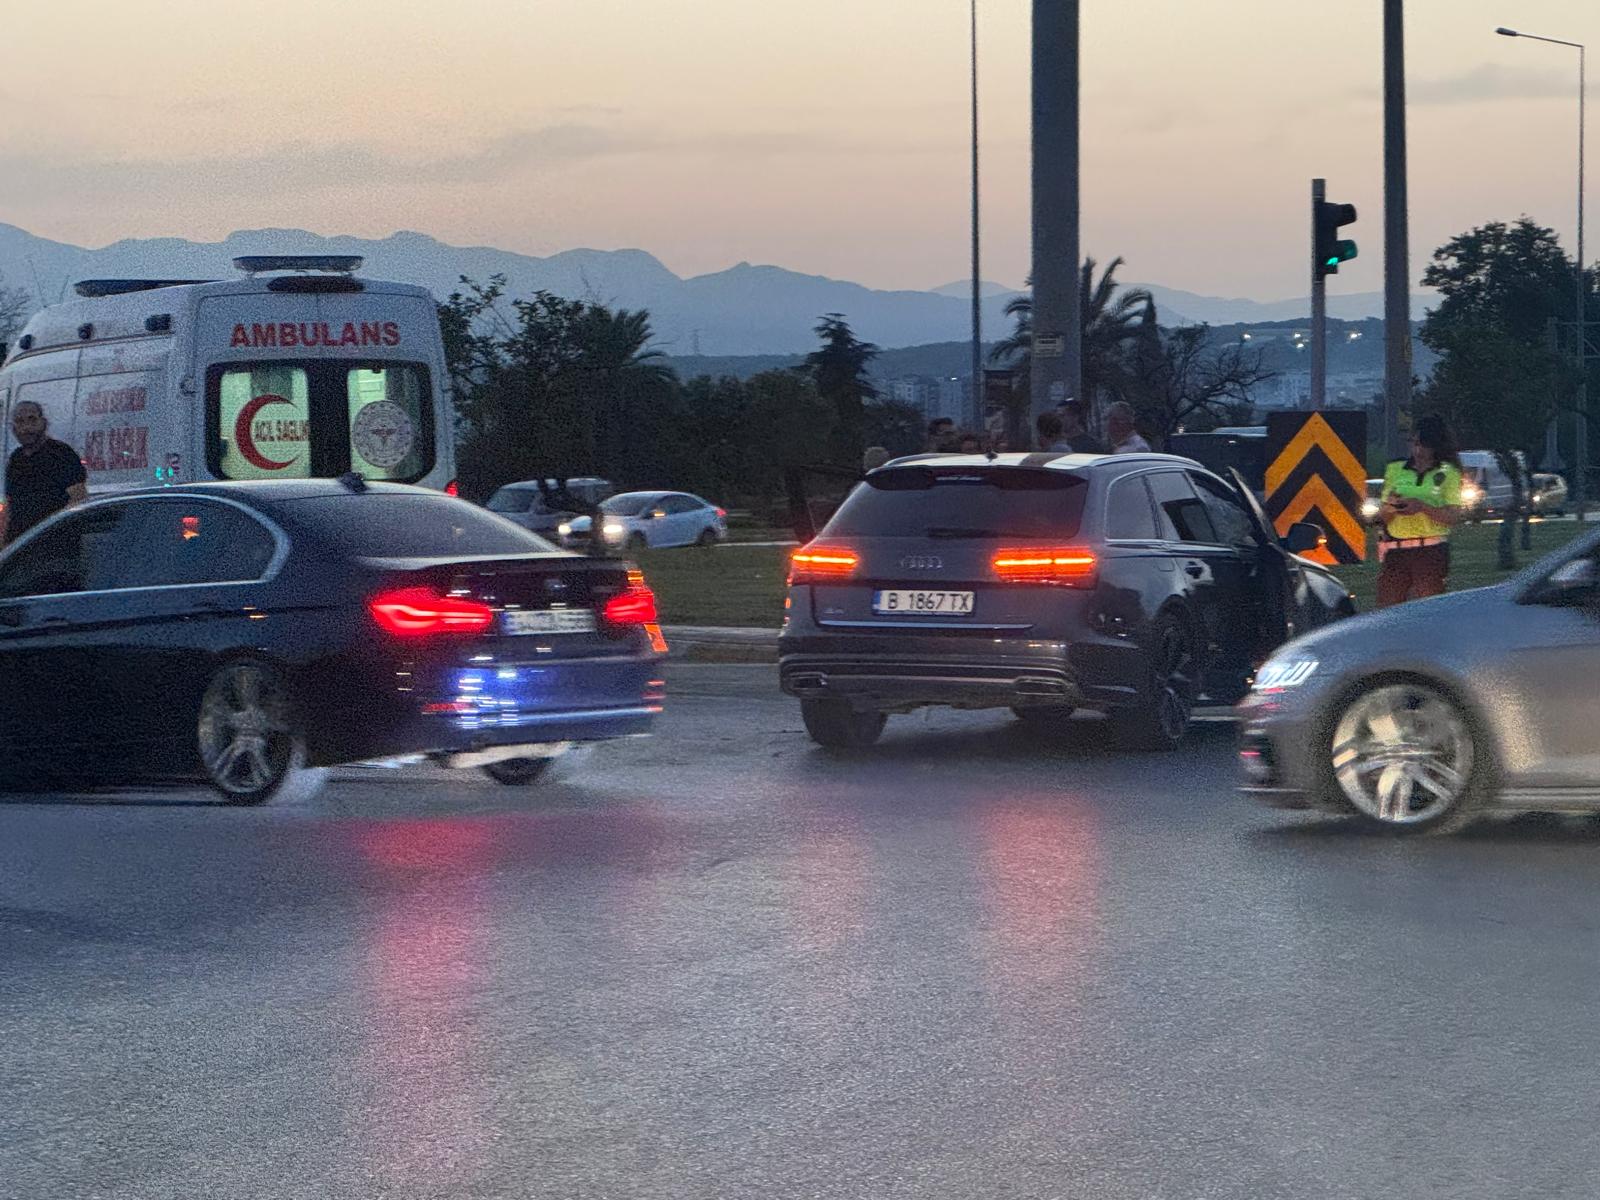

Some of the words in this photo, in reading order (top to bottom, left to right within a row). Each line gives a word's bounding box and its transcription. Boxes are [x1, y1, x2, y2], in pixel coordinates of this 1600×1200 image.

[230, 322, 400, 347] AMBULANS
[888, 592, 898, 610] B
[909, 592, 945, 610] 1867
[949, 593, 970, 611] TX
